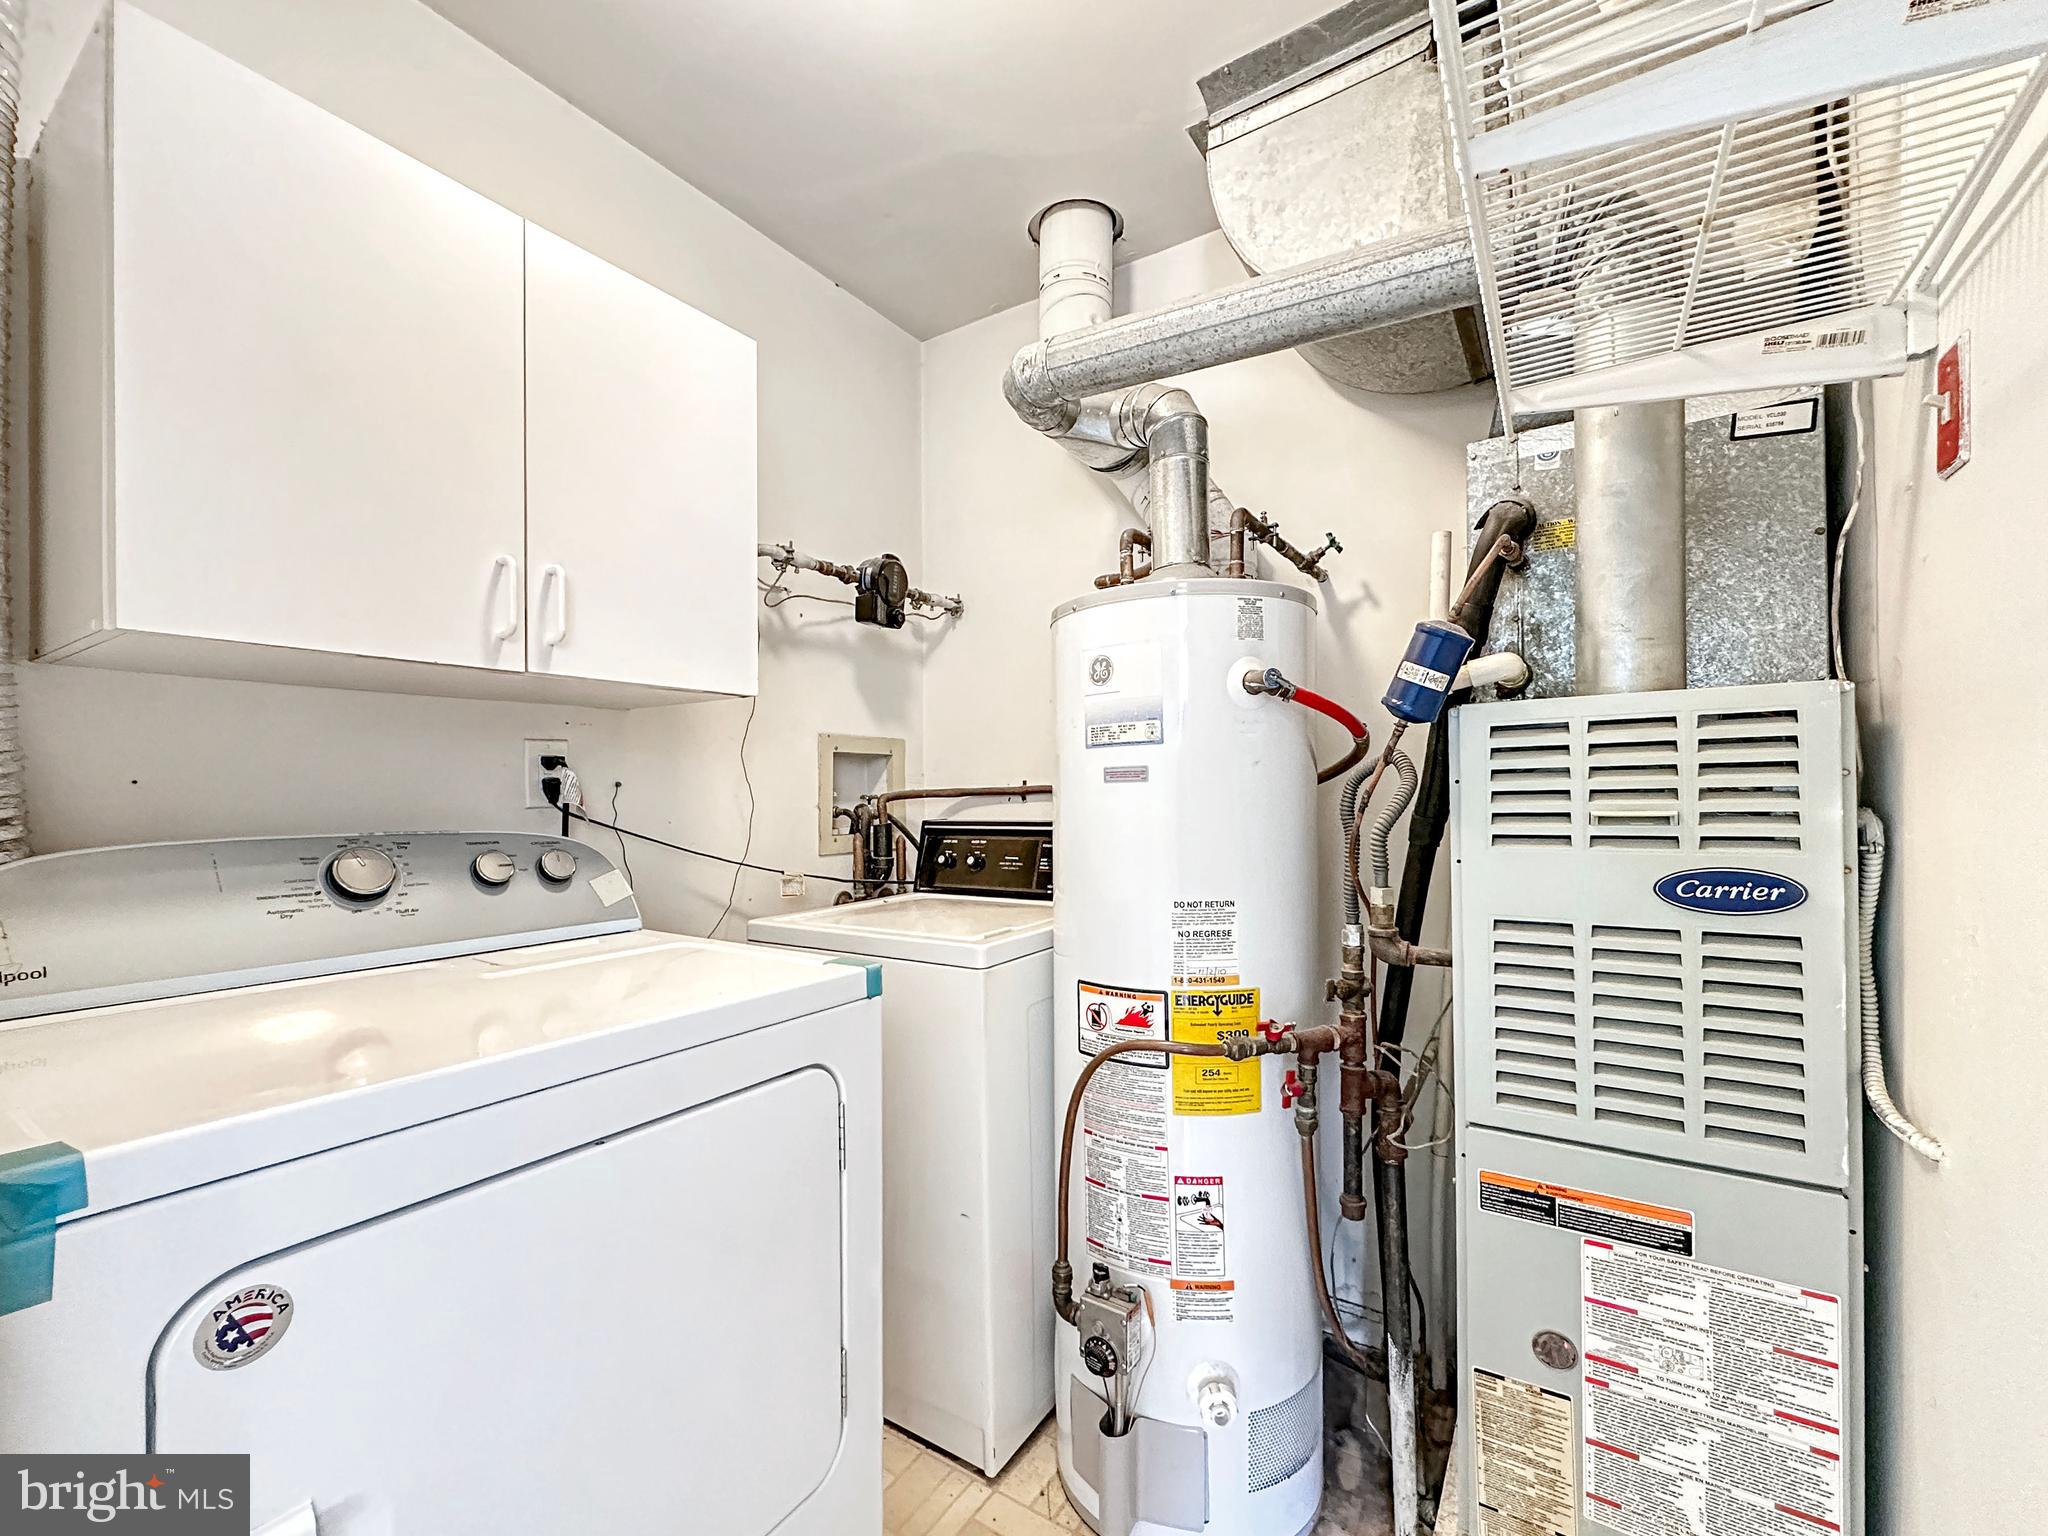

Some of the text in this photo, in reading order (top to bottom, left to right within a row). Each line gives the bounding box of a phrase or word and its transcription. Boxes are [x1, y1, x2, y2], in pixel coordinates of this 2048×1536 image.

[1737, 423, 1761, 431] SERIAL
[1676, 880, 1786, 901] Carrier
[1205, 900, 1235, 908] RETURN
[1178, 930, 1232, 938] NO REGRESE
[1173, 976, 1226, 984] 1-80-431-1549
[1105, 991, 1137, 1000] WARNING
[1175, 993, 1254, 1007] ENERGYGUIDE
[1202, 1069, 1220, 1077] 254
[1649, 1254, 1666, 1262] YOUR
[1667, 1257, 1690, 1268] SAFETY
[1691, 1264, 1709, 1272] READ
[1710, 1268, 1736, 1279] BEFORE
[1737, 1275, 1775, 1288] OPERATING
[213, 1288, 290, 1322] AMERICA
[1662, 1317, 1746, 1344] OPERATING INSTRUCTIONS
[1665, 1377, 1682, 1387] TURN
[1696, 1387, 1711, 1395] GAS
[1721, 1394, 1758, 1410] APPLIANCE
